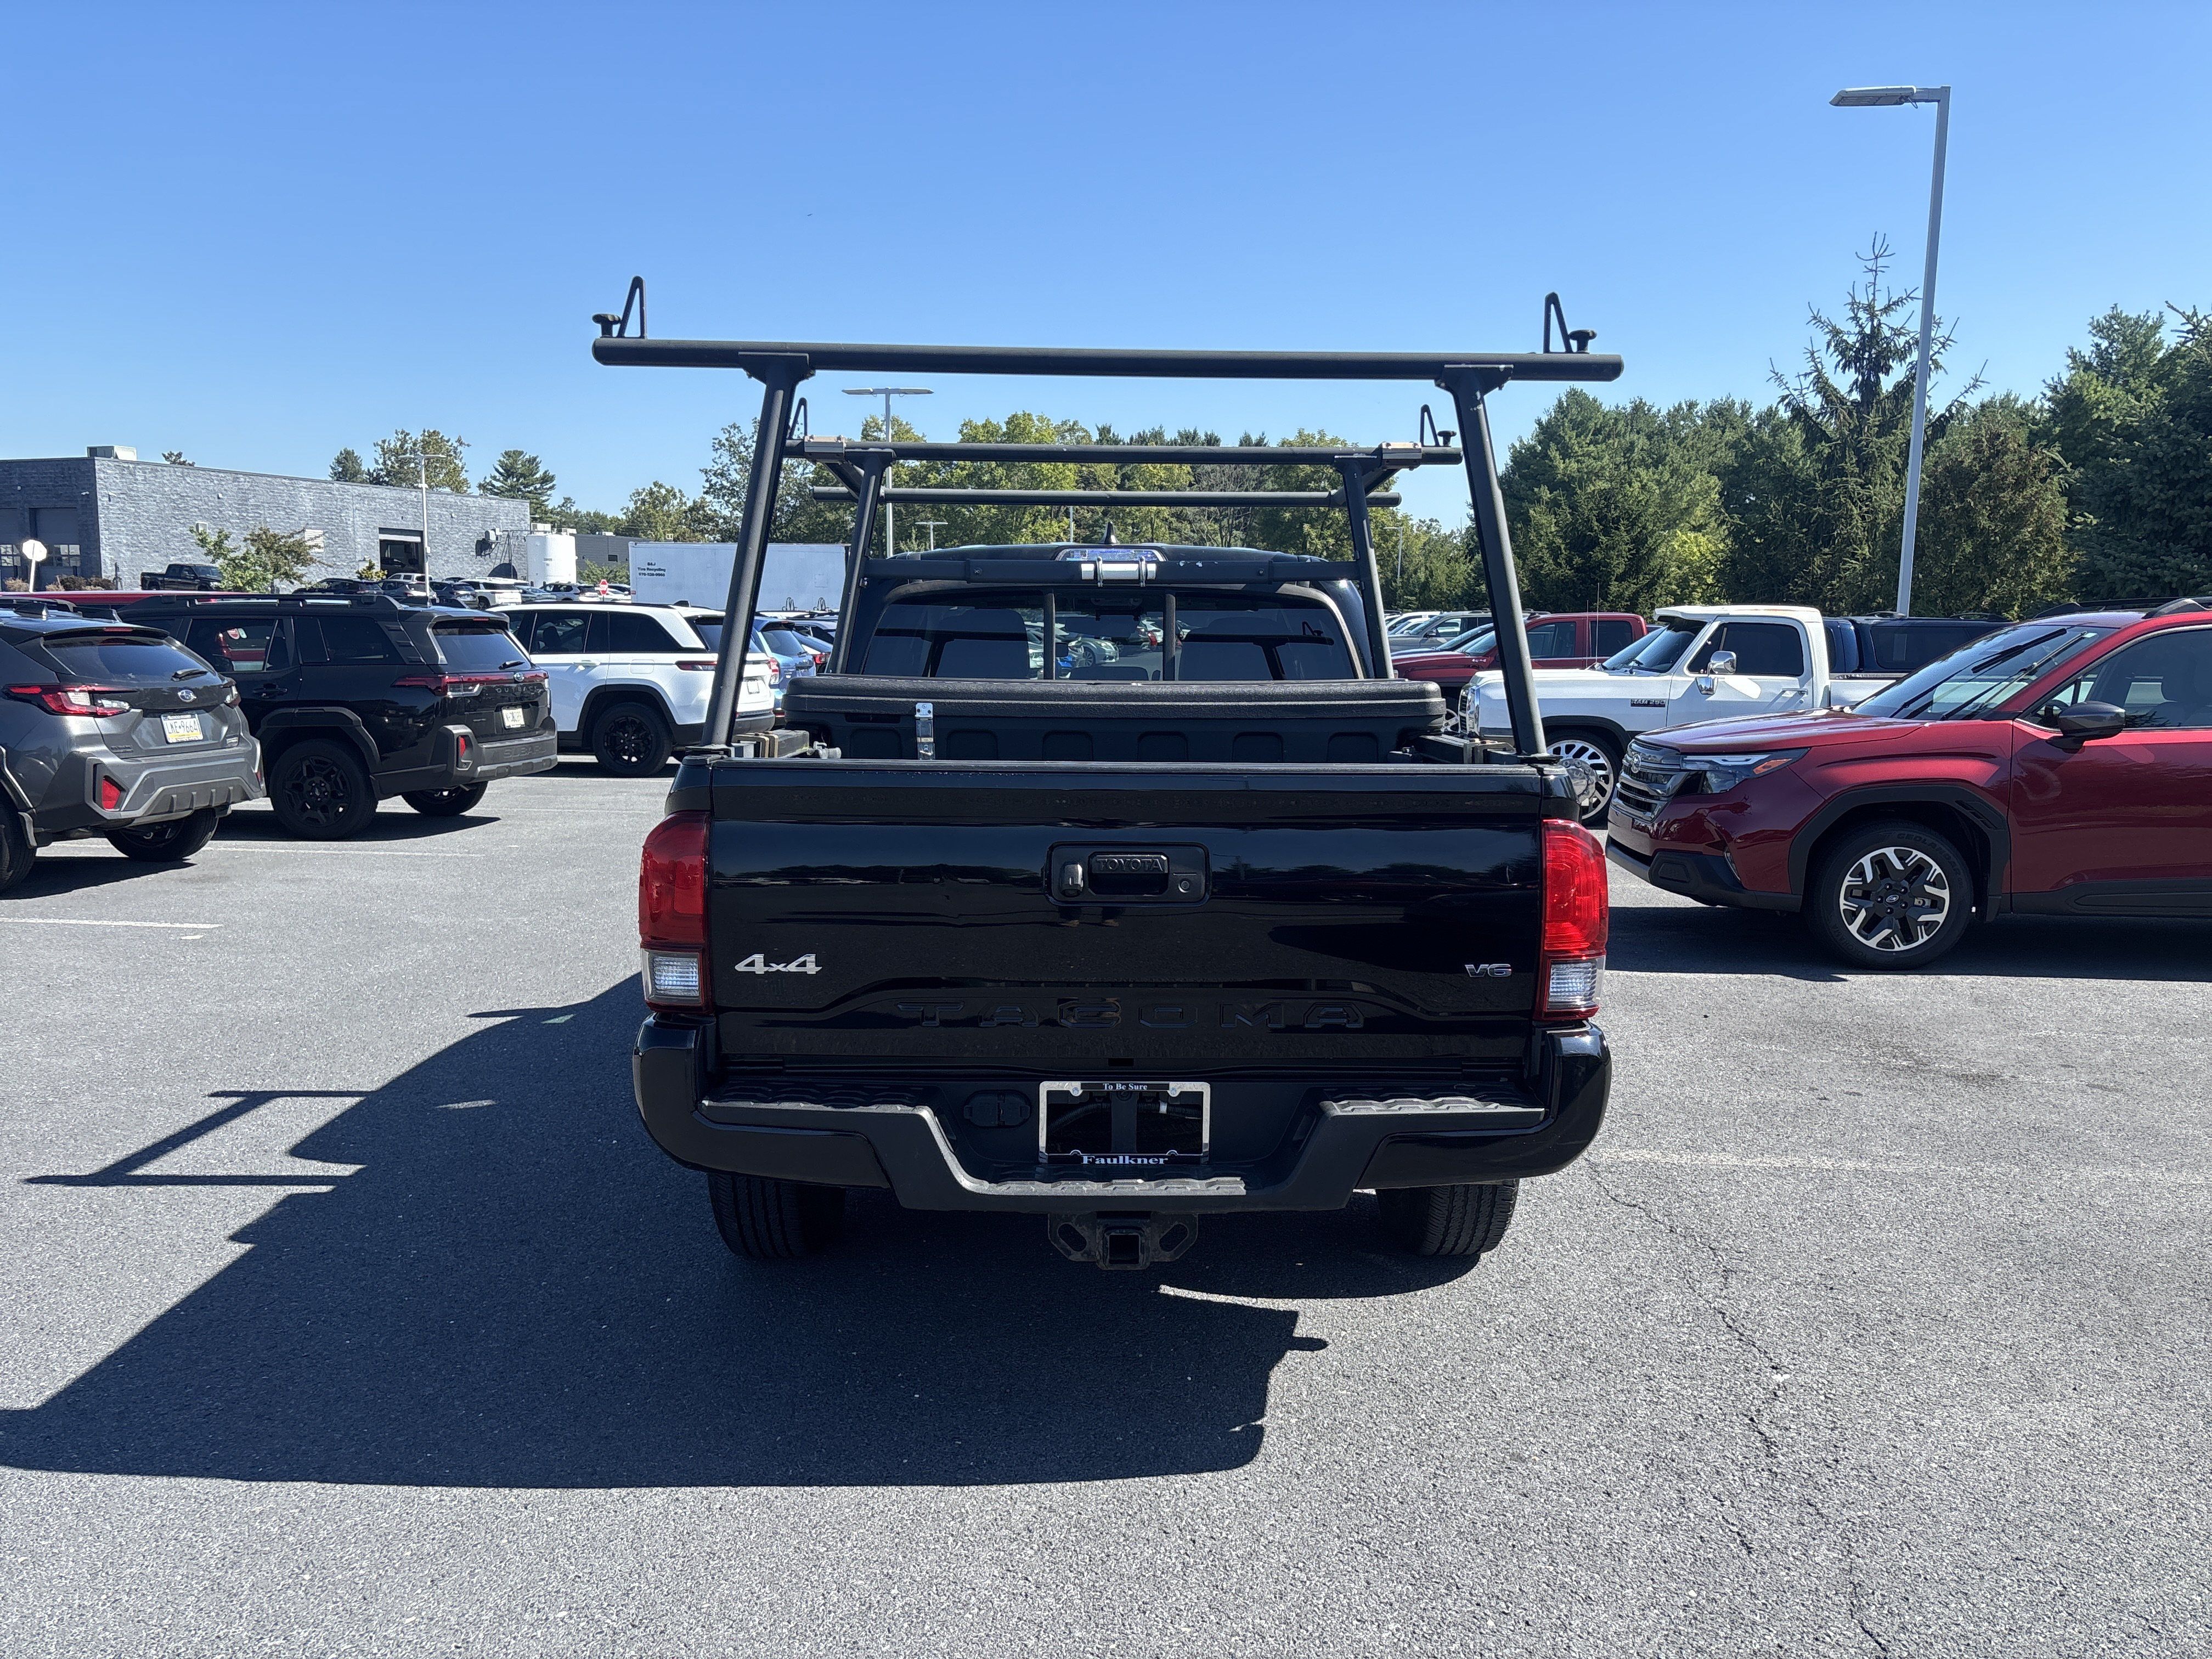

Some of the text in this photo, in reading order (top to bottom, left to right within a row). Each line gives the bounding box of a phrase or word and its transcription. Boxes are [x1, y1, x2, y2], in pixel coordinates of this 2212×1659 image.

[1097, 858, 1163, 871] TOYOTA
[735, 953, 822, 974] 4x4
[1465, 964, 1511, 977] V6
[896, 1000, 1364, 1029] TACOMA
[1081, 1155, 1169, 1164] Faulkner
